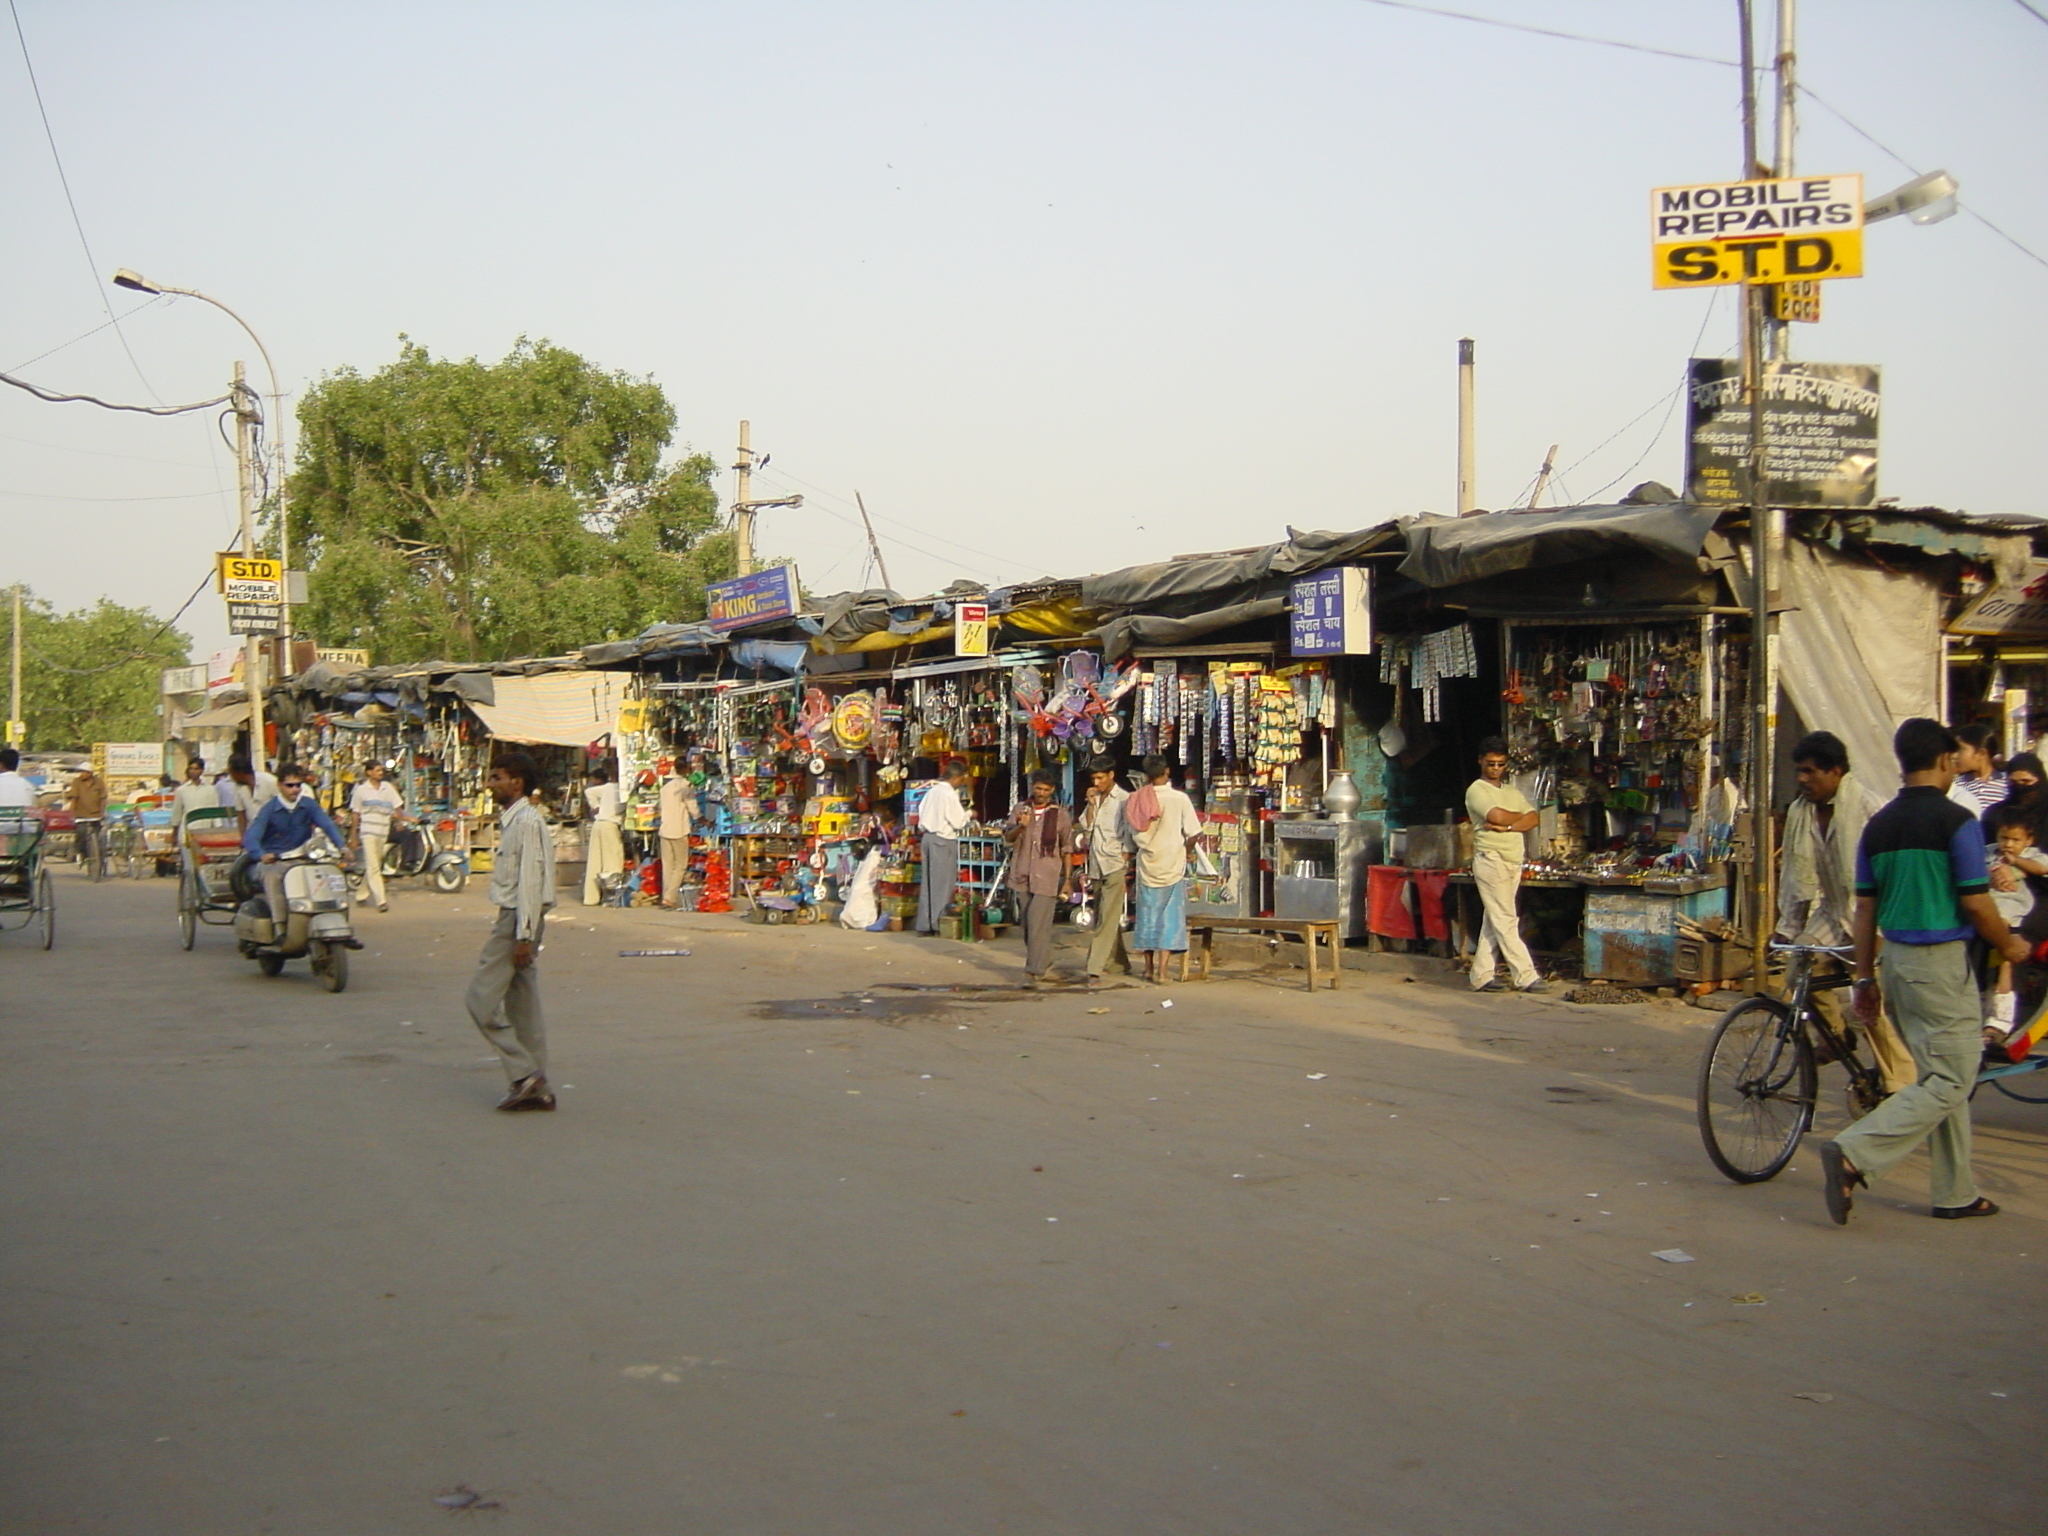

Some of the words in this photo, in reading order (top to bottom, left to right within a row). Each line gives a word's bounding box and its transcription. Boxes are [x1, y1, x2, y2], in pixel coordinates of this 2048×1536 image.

[1661, 180, 1831, 212] MOBILE
[1658, 203, 1853, 236] REPAIRS
[1667, 238, 1842, 282] S.T.D.
[232, 561, 276, 578] S.T.D.
[226, 593, 279, 601] REPAIRS
[228, 584, 277, 593] MOBILE
[724, 594, 757, 620] KING
